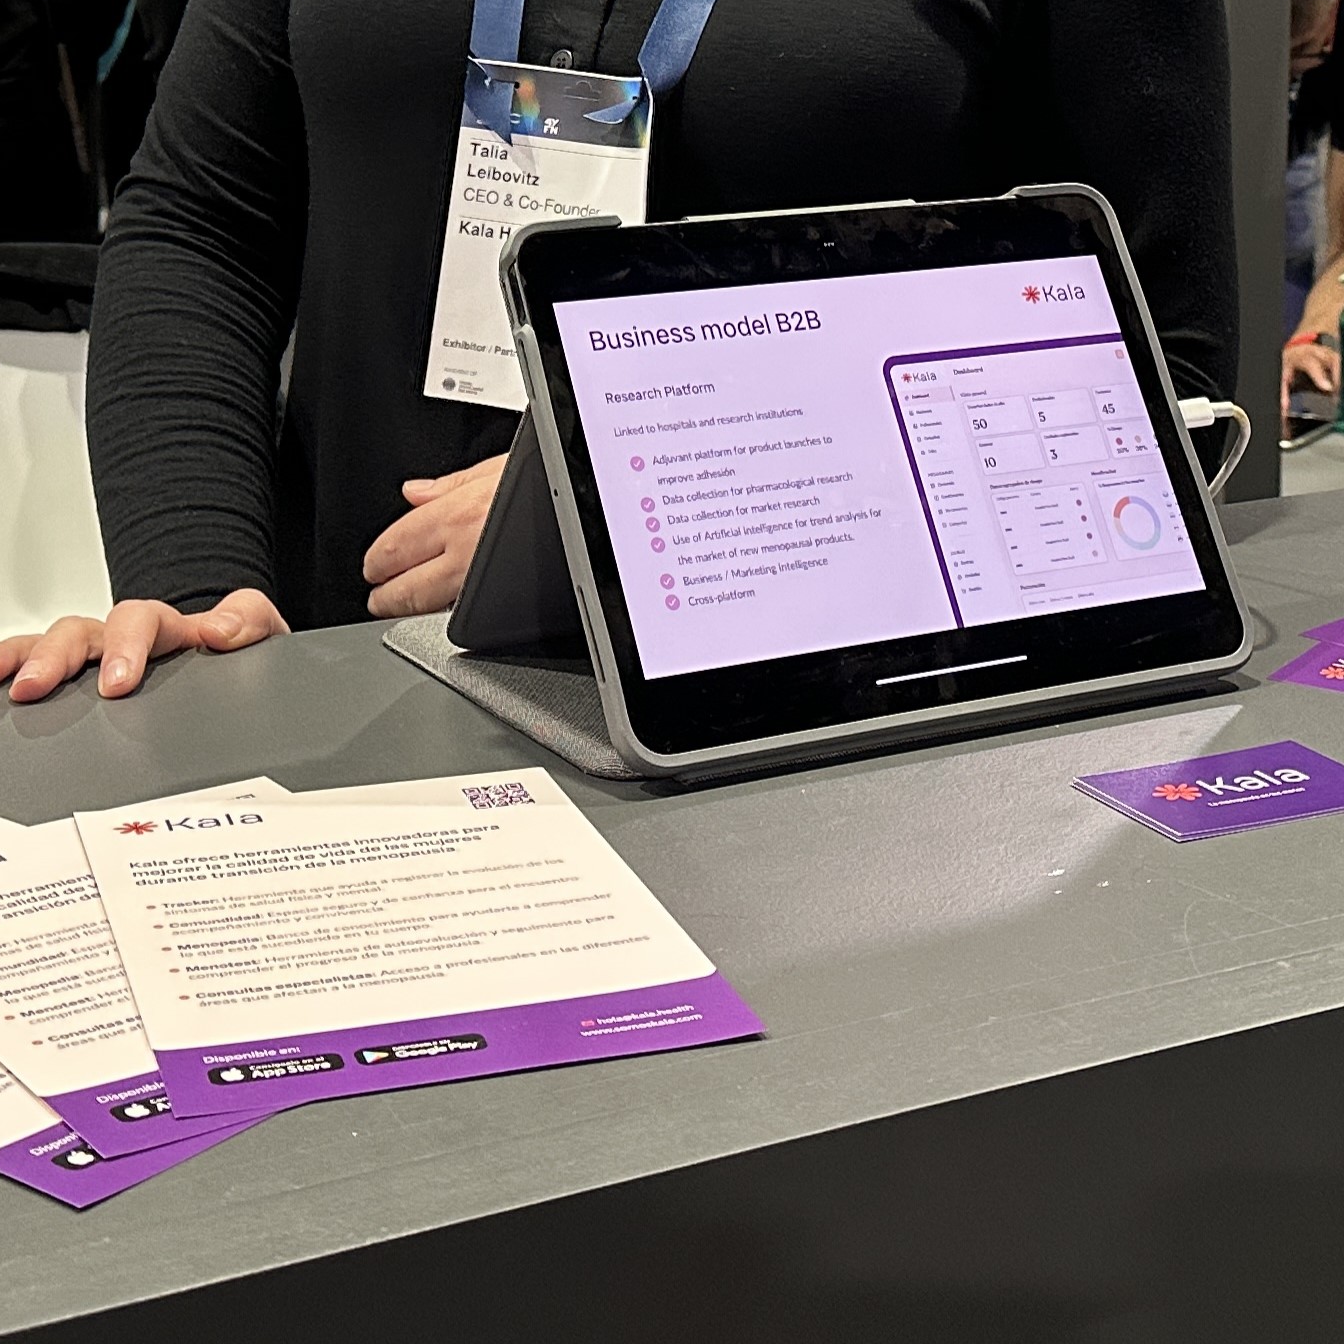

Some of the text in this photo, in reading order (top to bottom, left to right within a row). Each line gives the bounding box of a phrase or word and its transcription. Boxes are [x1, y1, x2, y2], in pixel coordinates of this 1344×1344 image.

[471, 143, 508, 160] Talia
[467, 164, 540, 186] Leibovitz
[463, 187, 600, 217] CEO & Co-Founder
[459, 220, 494, 238] Kala
[1042, 284, 1085, 301] Kala
[589, 310, 820, 350] Business model B2B
[443, 338, 486, 352] Exhibitor
[488, 345, 493, 354] /
[910, 371, 936, 382] Kala
[605, 383, 715, 403] Research Platform
[1038, 411, 1046, 422] 5
[1102, 403, 1115, 414] 45
[613, 408, 803, 437] Linked to hospitals and research institutions
[972, 418, 987, 430] 50
[653, 452, 692, 465] Adjuvant
[694, 449, 732, 461] platform
[733, 445, 746, 455] for
[748, 441, 783, 455] product
[822, 436, 832, 444] to
[1049, 448, 1057, 459] 3
[984, 457, 996, 468] 10
[657, 474, 694, 485] improve
[662, 472, 853, 505] Data collection for pharmacological research
[667, 496, 820, 524] Data collection for market research
[672, 535, 690, 545] Use
[692, 532, 701, 542] of
[704, 527, 741, 540] Artificial
[794, 519, 807, 527] for
[809, 514, 833, 526] trend
[835, 510, 868, 522] analysis
[869, 508, 881, 517] for
[677, 555, 693, 565] the
[695, 550, 726, 563] market
[728, 547, 737, 558] of
[740, 547, 758, 556] new
[761, 537, 812, 553] menopausal
[682, 558, 828, 586] Business / Marketing Intelligence
[688, 589, 755, 606] Cross-platform
[1196, 768, 1310, 796] Kala
[164, 810, 265, 832] Kala
[129, 825, 499, 868] Kala ofrece herramientas innovadoras para
[132, 866, 200, 877] mejorar
[226, 856, 289, 868] calidad
[319, 849, 355, 857] vida
[413, 835, 481, 847] mujeres
[135, 875, 206, 885] durante
[211, 865, 300, 878] transición
[63, 886, 85, 894] de
[203, 1049, 276, 1063] Disponible
[393, 1042, 447, 1057] Google
[444, 1041, 478, 1050] Play
[252, 1065, 286, 1078] App
[285, 1060, 330, 1073] Store
